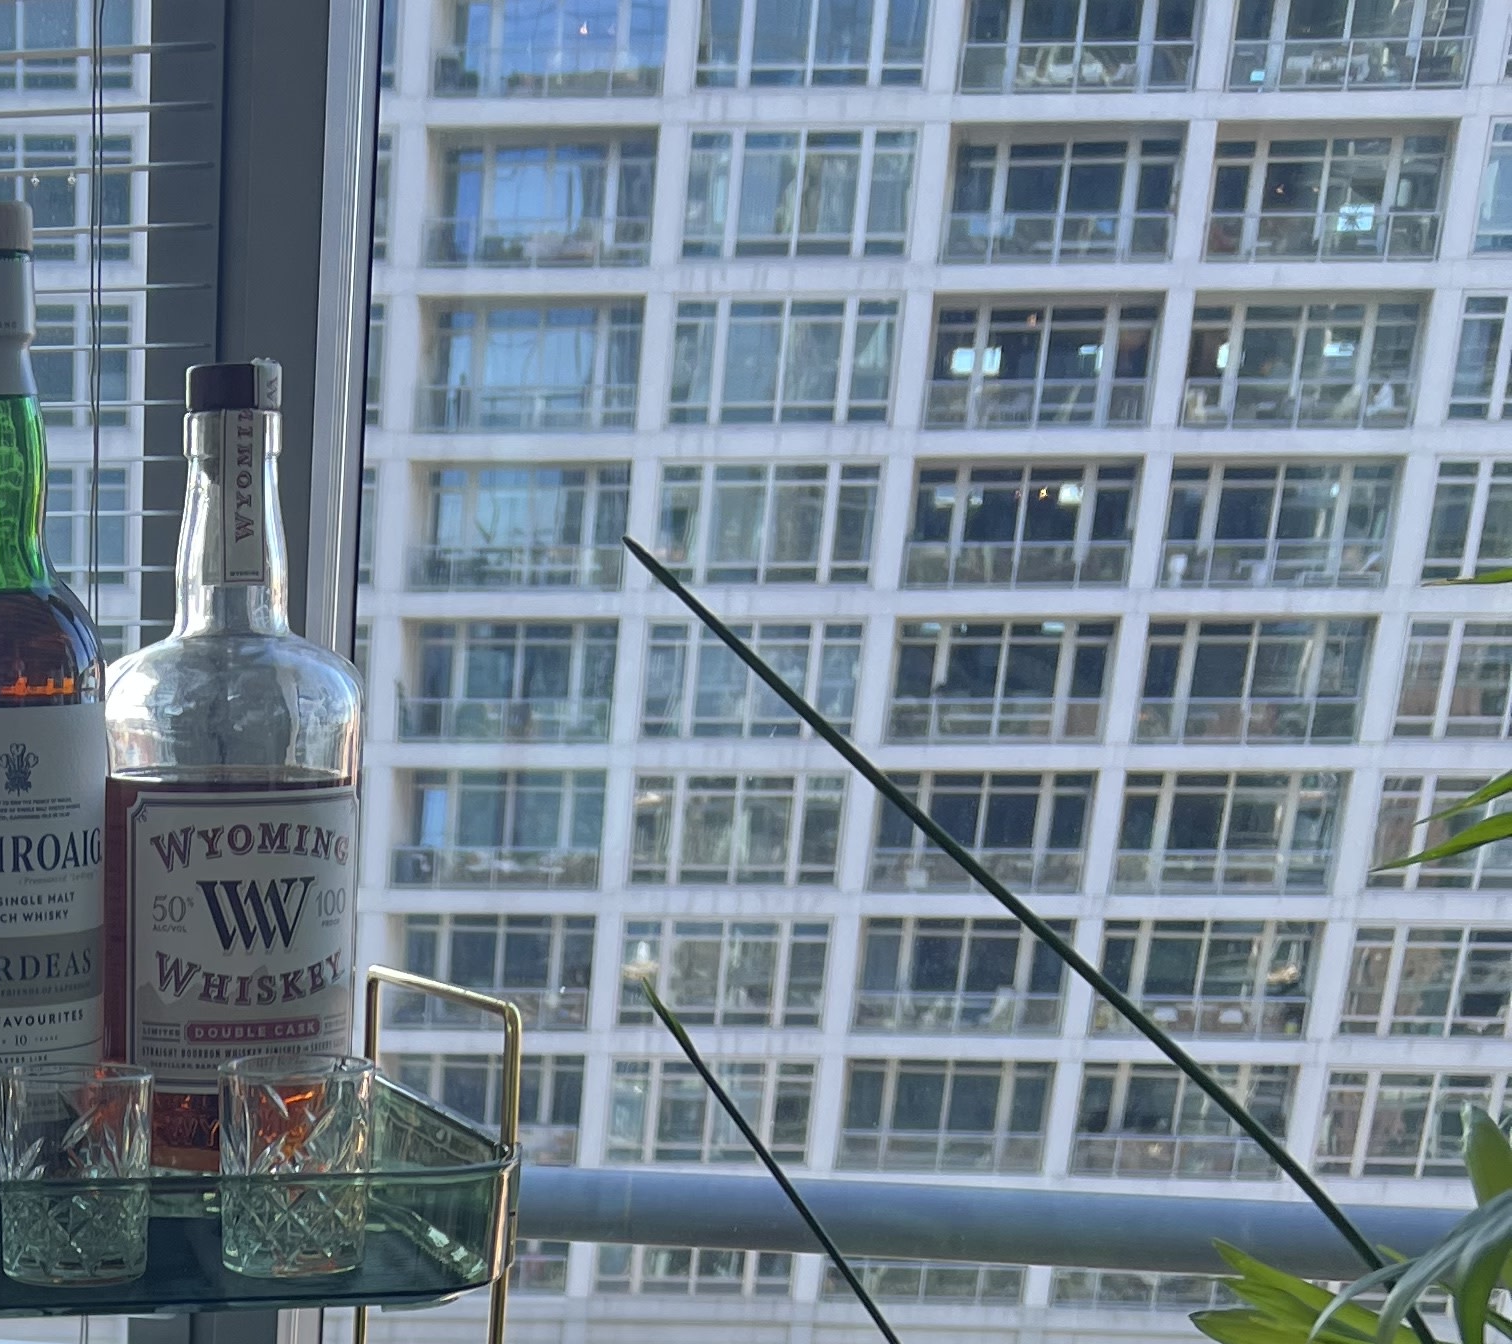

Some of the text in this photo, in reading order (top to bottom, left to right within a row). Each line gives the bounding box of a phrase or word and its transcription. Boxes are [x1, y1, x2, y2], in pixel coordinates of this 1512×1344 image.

[150, 822, 349, 873] WYOMING
[47, 892, 75, 905] MALT
[315, 887, 346, 919] 100
[22, 909, 69, 923] WHISKY
[155, 947, 345, 1006] WHISKEY
[194, 1025, 266, 1039] DOUBLE
[274, 1022, 315, 1036] CASK
[14, 1035, 28, 1046] 10
[181, 1047, 220, 1058] BOURBON
